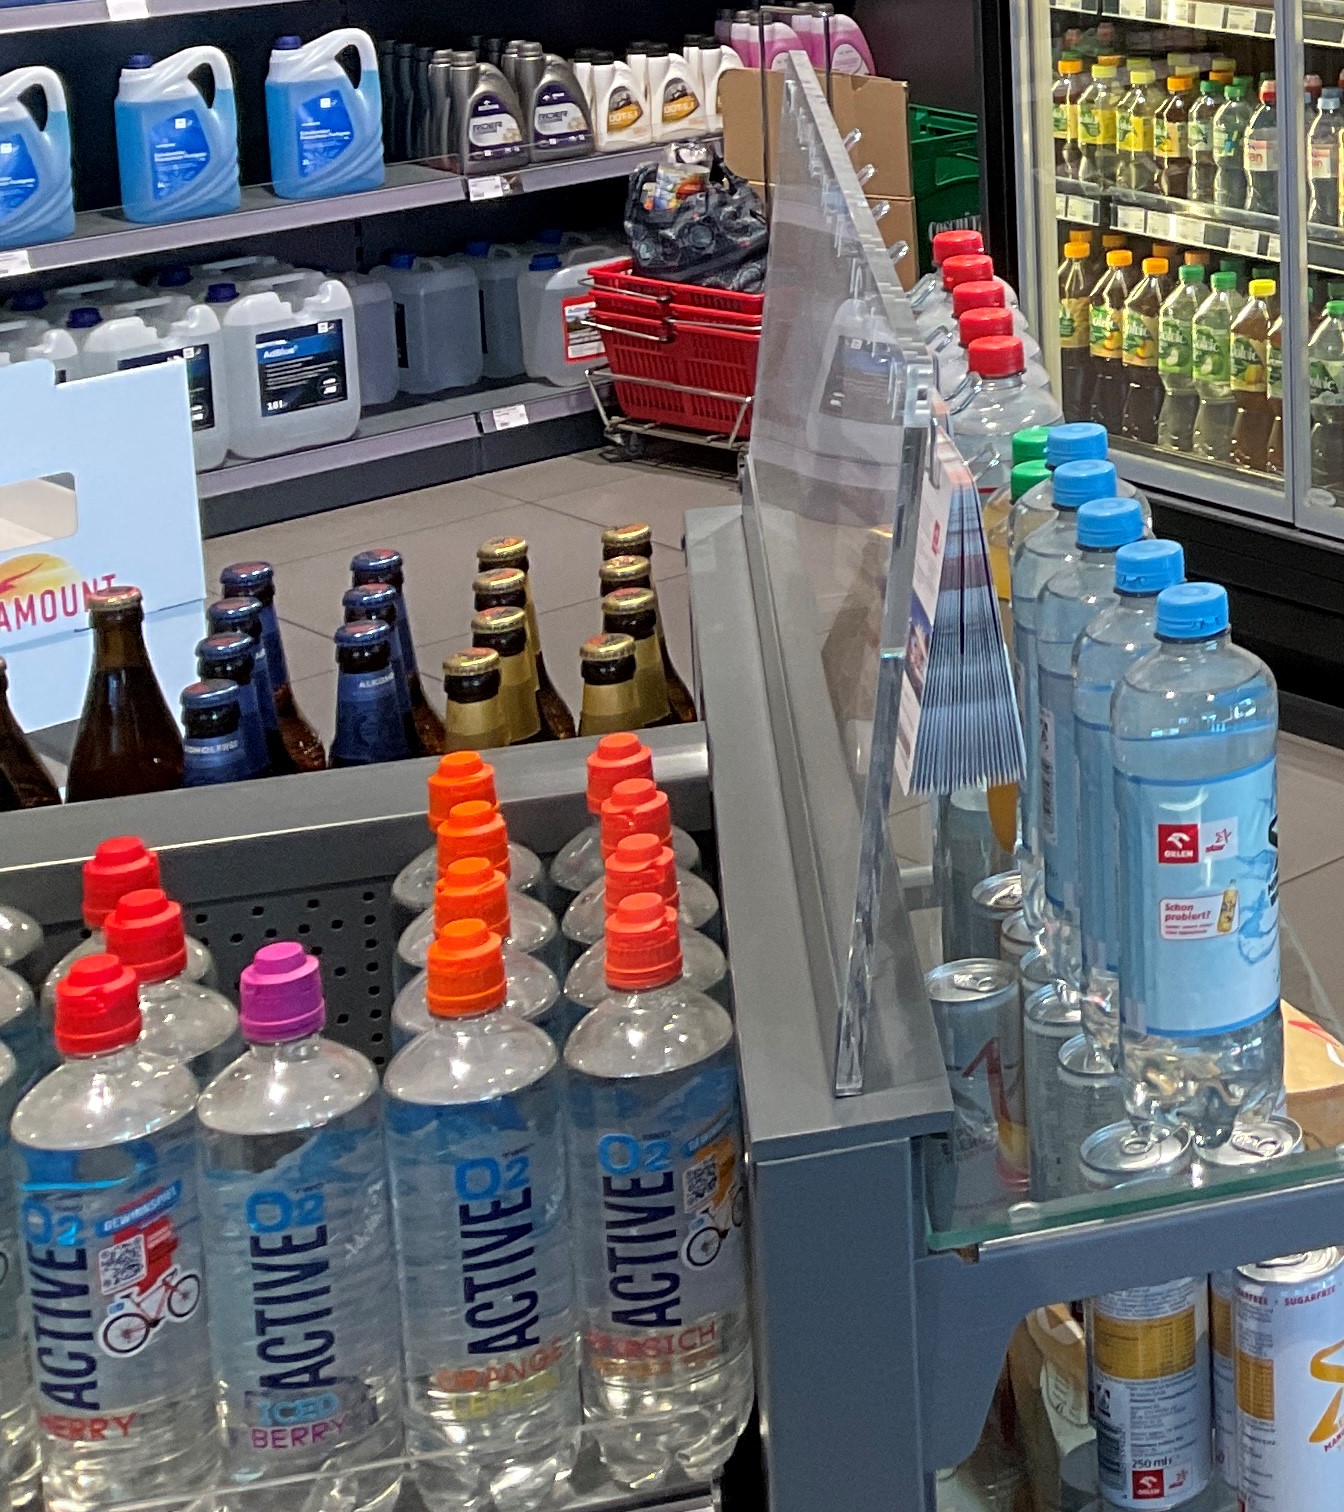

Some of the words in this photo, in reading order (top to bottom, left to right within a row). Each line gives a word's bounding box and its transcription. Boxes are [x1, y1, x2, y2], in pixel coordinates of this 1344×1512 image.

[1165, 903, 1194, 911] Schon
[1165, 910, 1211, 922] probiert?
[598, 1134, 673, 1175] O2
[455, 1156, 530, 1202] O2
[245, 1187, 326, 1234] O2
[459, 1186, 540, 1354] ACTIVE
[603, 1172, 682, 1327] ACTIVE
[250, 1225, 337, 1390] ACTIVE
[1283, 1284, 1337, 1307] SUGARFREE
[26, 1240, 101, 1411] ACTIVE
[257, 1392, 341, 1423] ICED
[251, 1417, 350, 1450] BERRY
[1131, 1458, 1152, 1469] 250
